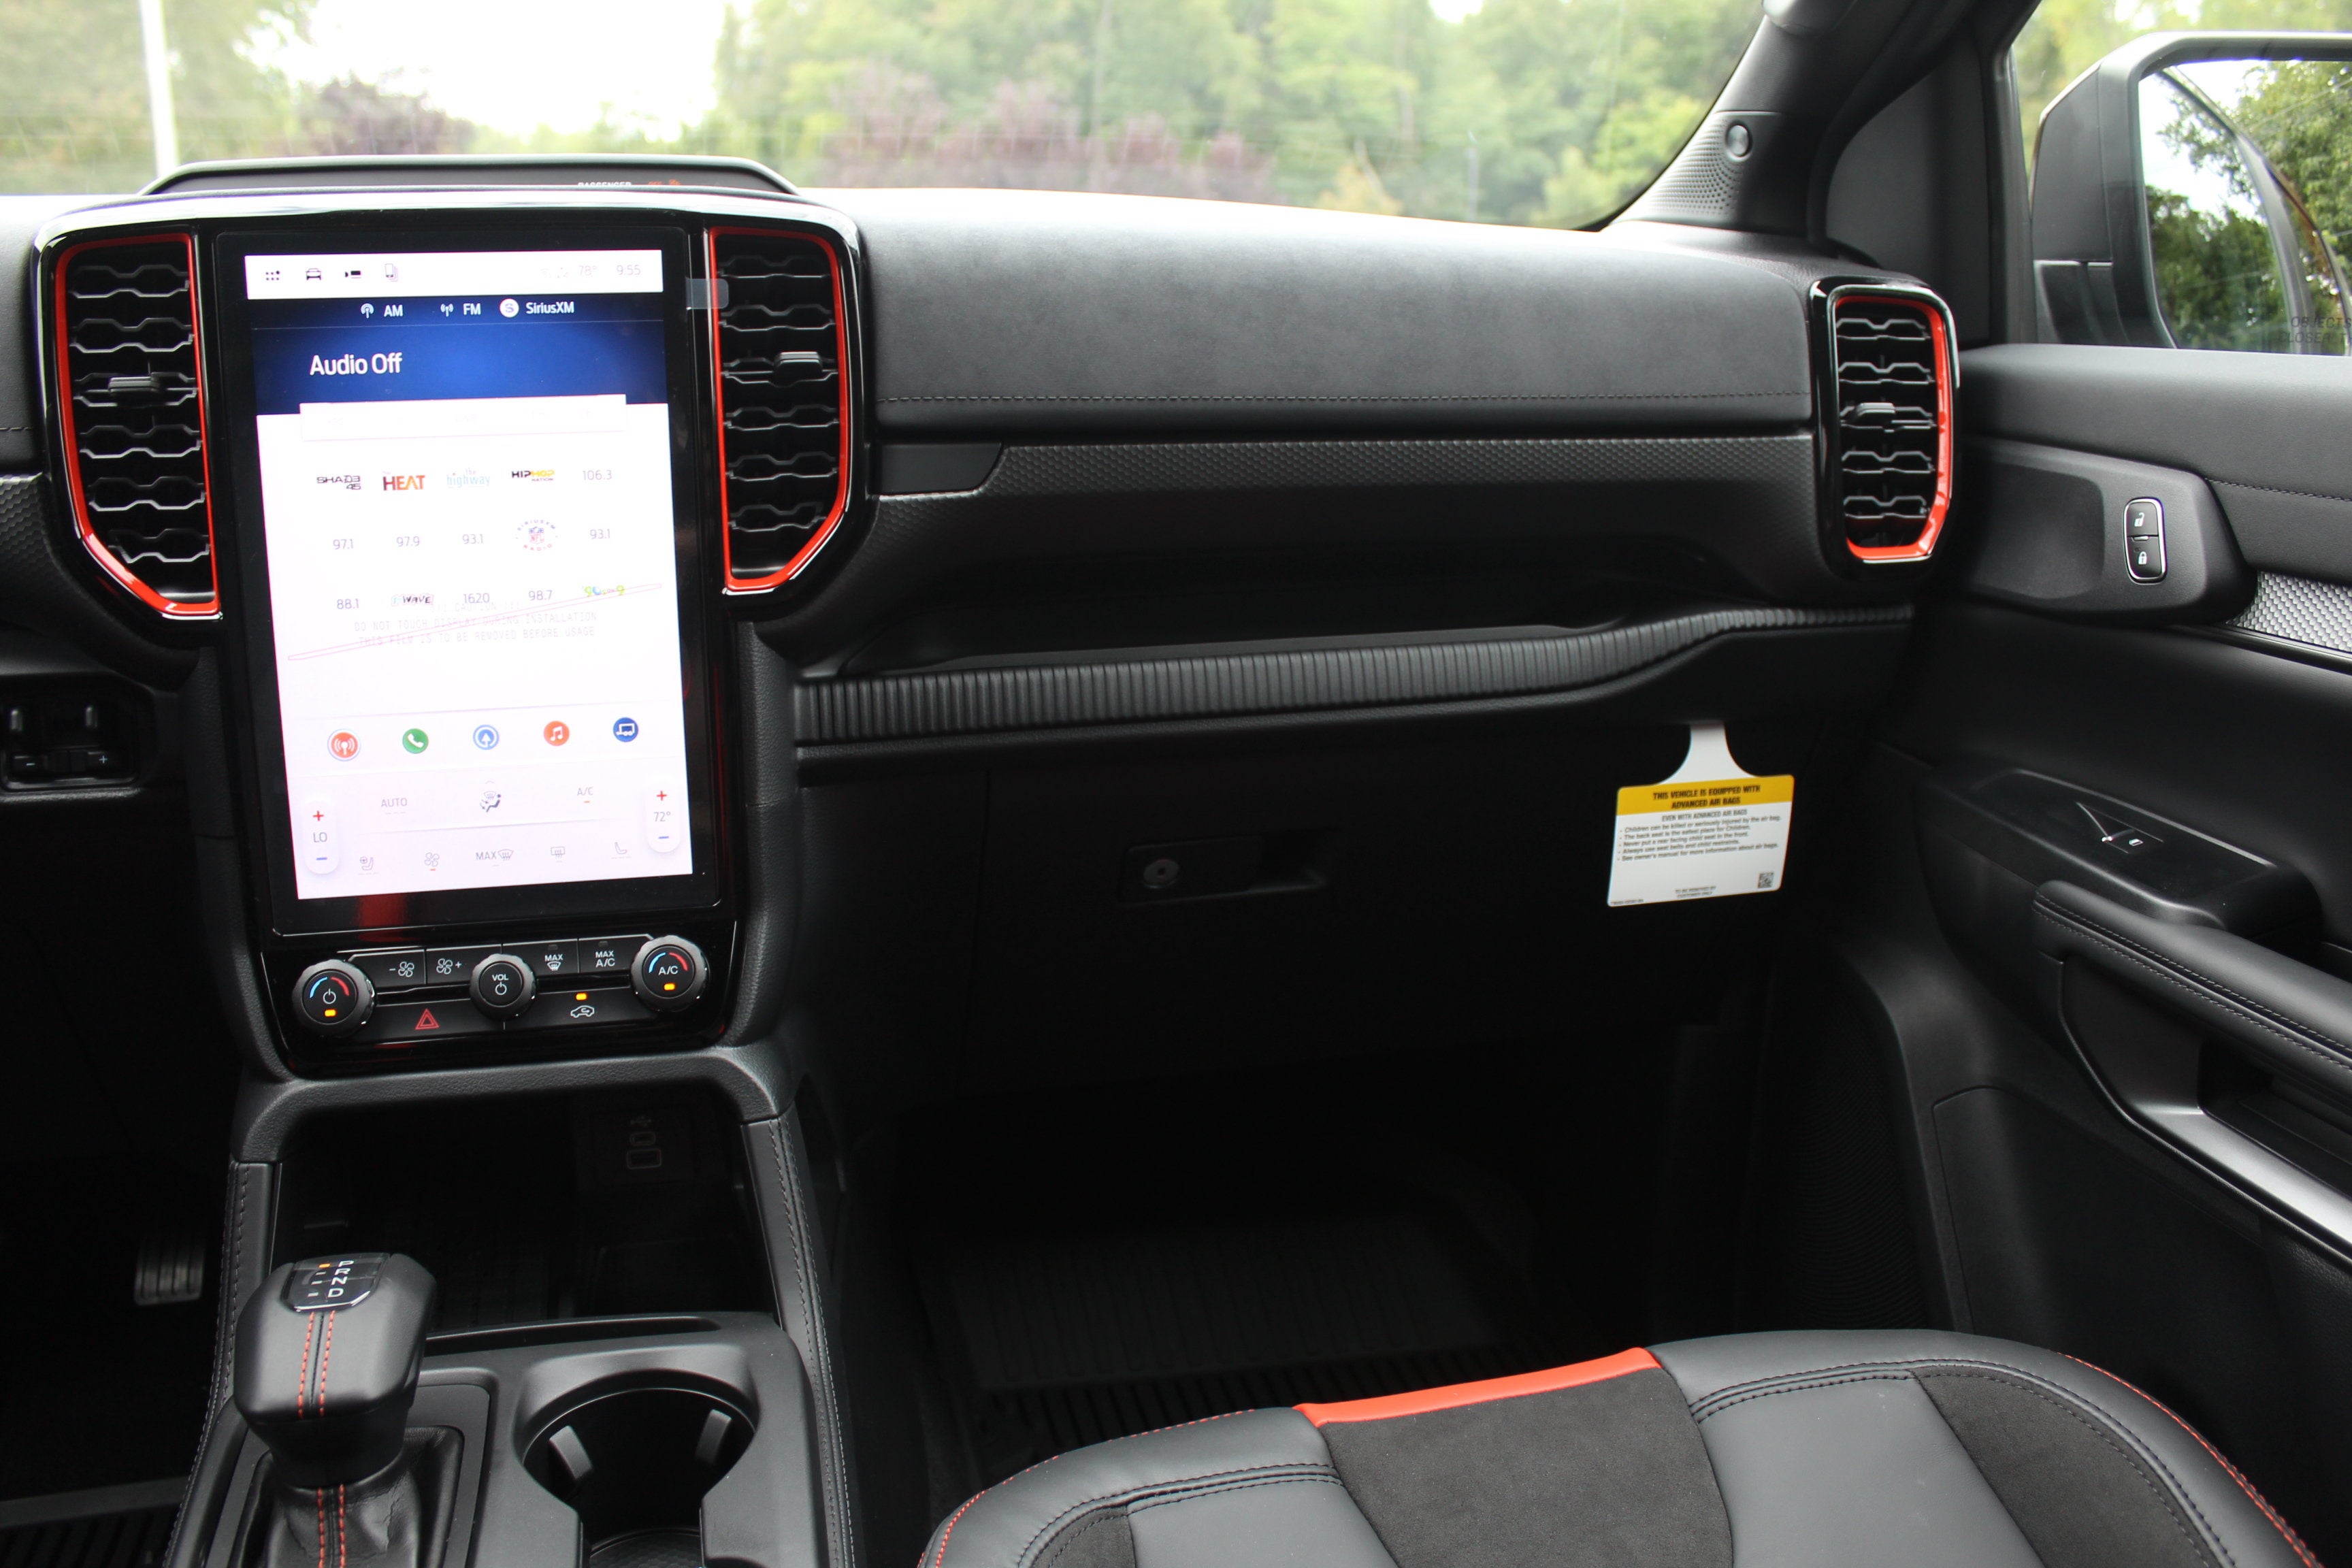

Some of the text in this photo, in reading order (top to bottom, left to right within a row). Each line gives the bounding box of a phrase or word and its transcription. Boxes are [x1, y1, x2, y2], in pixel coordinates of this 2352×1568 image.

[616, 264, 642, 276] 9:55
[383, 304, 404, 317] AM
[463, 303, 482, 315] FM
[525, 301, 575, 314] SiriusXM
[2291, 316, 2352, 328] OBJECTS
[309, 353, 404, 376] Audio Off
[446, 472, 491, 488] highway
[583, 469, 612, 480] 106.3
[382, 474, 426, 491] HEAT
[461, 534, 485, 545] 93.1
[589, 528, 611, 540] 93.1
[332, 538, 355, 550] 97.1
[395, 536, 421, 548] 97.9
[402, 594, 431, 604] WAVE
[463, 593, 491, 604] 1620
[527, 590, 553, 602] 98.7
[336, 598, 360, 610] 88.1
[353, 621, 367, 632] DO
[373, 620, 391, 631] NOT
[397, 619, 428, 630] TOUCH
[525, 611, 598, 624] INSTALLATION
[457, 631, 469, 642] BE
[474, 630, 517, 641] REMOVED
[523, 627, 559, 639] BEFORE
[565, 626, 595, 637] USAGE
[576, 786, 594, 797] A/C
[1653, 792, 1669, 800] THIS
[1671, 789, 1698, 798] VEHICLE
[1708, 786, 1742, 796] EQUIPPED
[1743, 784, 1761, 793] WITH
[380, 797, 408, 808] AUTO
[1671, 796, 1741, 809] ADVANCED AIR BAGS
[653, 811, 672, 823] 72°
[1693, 811, 1722, 819] ADVANCED
[313, 832, 328, 843] LO
[476, 851, 497, 862] MAX
[544, 953, 564, 962] MAX
[595, 949, 614, 958] MAX
[595, 958, 616, 968] A/C
[657, 965, 679, 975] A/C
[331, 1277, 348, 1286] N
[327, 1288, 344, 1298] D
